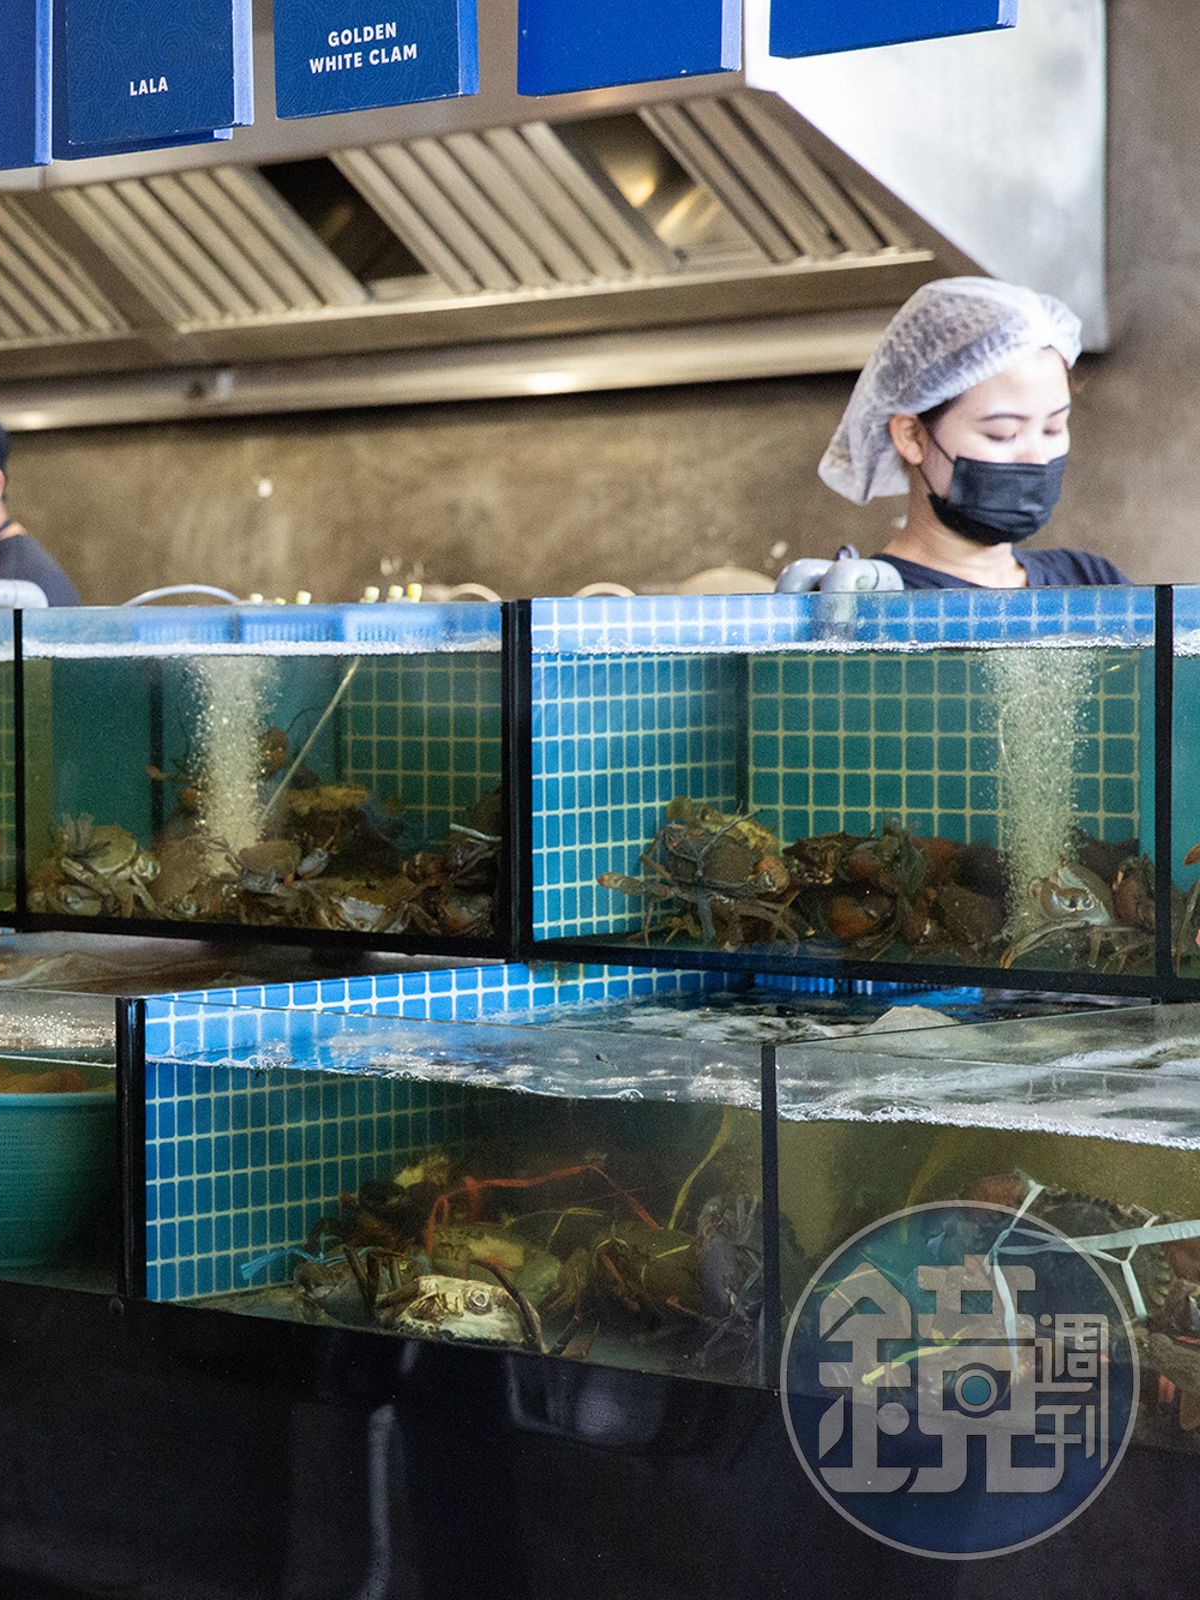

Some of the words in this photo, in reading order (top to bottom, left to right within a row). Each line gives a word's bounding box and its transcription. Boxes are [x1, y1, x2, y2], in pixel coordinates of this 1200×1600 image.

[327, 22, 397, 48] GOLDEN
[309, 48, 363, 75] WHITE
[368, 43, 418, 66] CLAM
[129, 76, 169, 97] LALA
